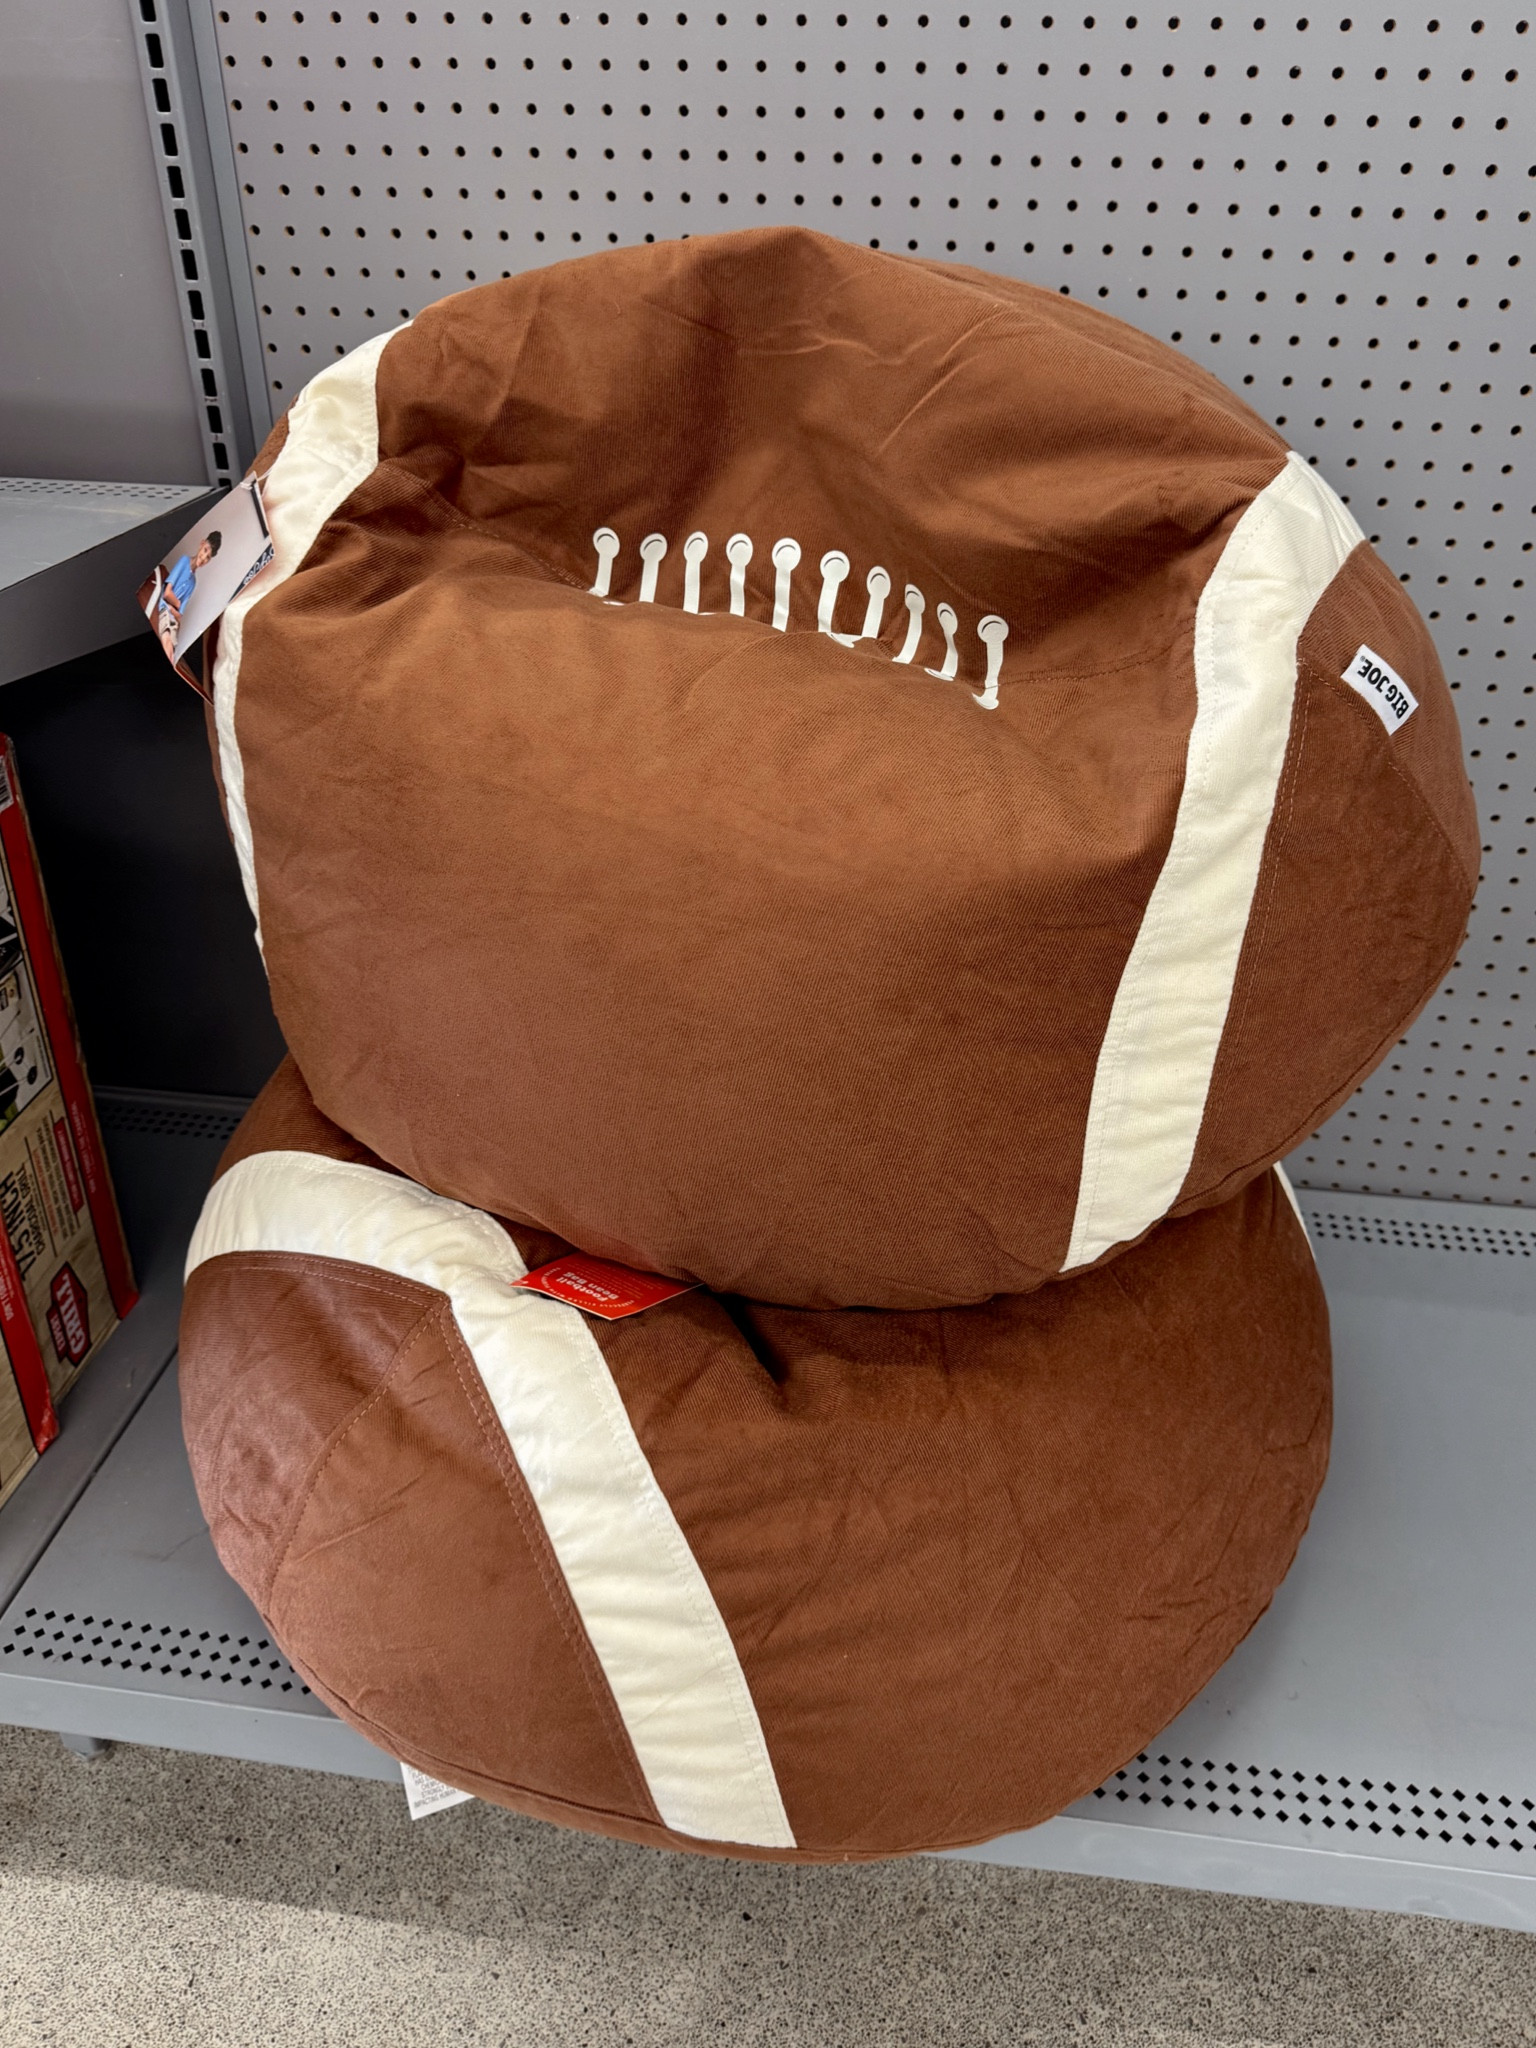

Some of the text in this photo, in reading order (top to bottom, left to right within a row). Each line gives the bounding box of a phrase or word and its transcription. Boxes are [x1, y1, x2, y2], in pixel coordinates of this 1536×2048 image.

[1384, 684, 1410, 719] BIG
[16, 1162, 31, 1199] GRILL
[0, 1171, 26, 1236] INCH
[26, 1194, 45, 1256] CHARCOAL
[556, 1276, 609, 1303] Football
[562, 1271, 588, 1285] Bag
[588, 1283, 619, 1301] Bean
[50, 1313, 66, 1351] EXPERT
[57, 1273, 85, 1354] GRILL
